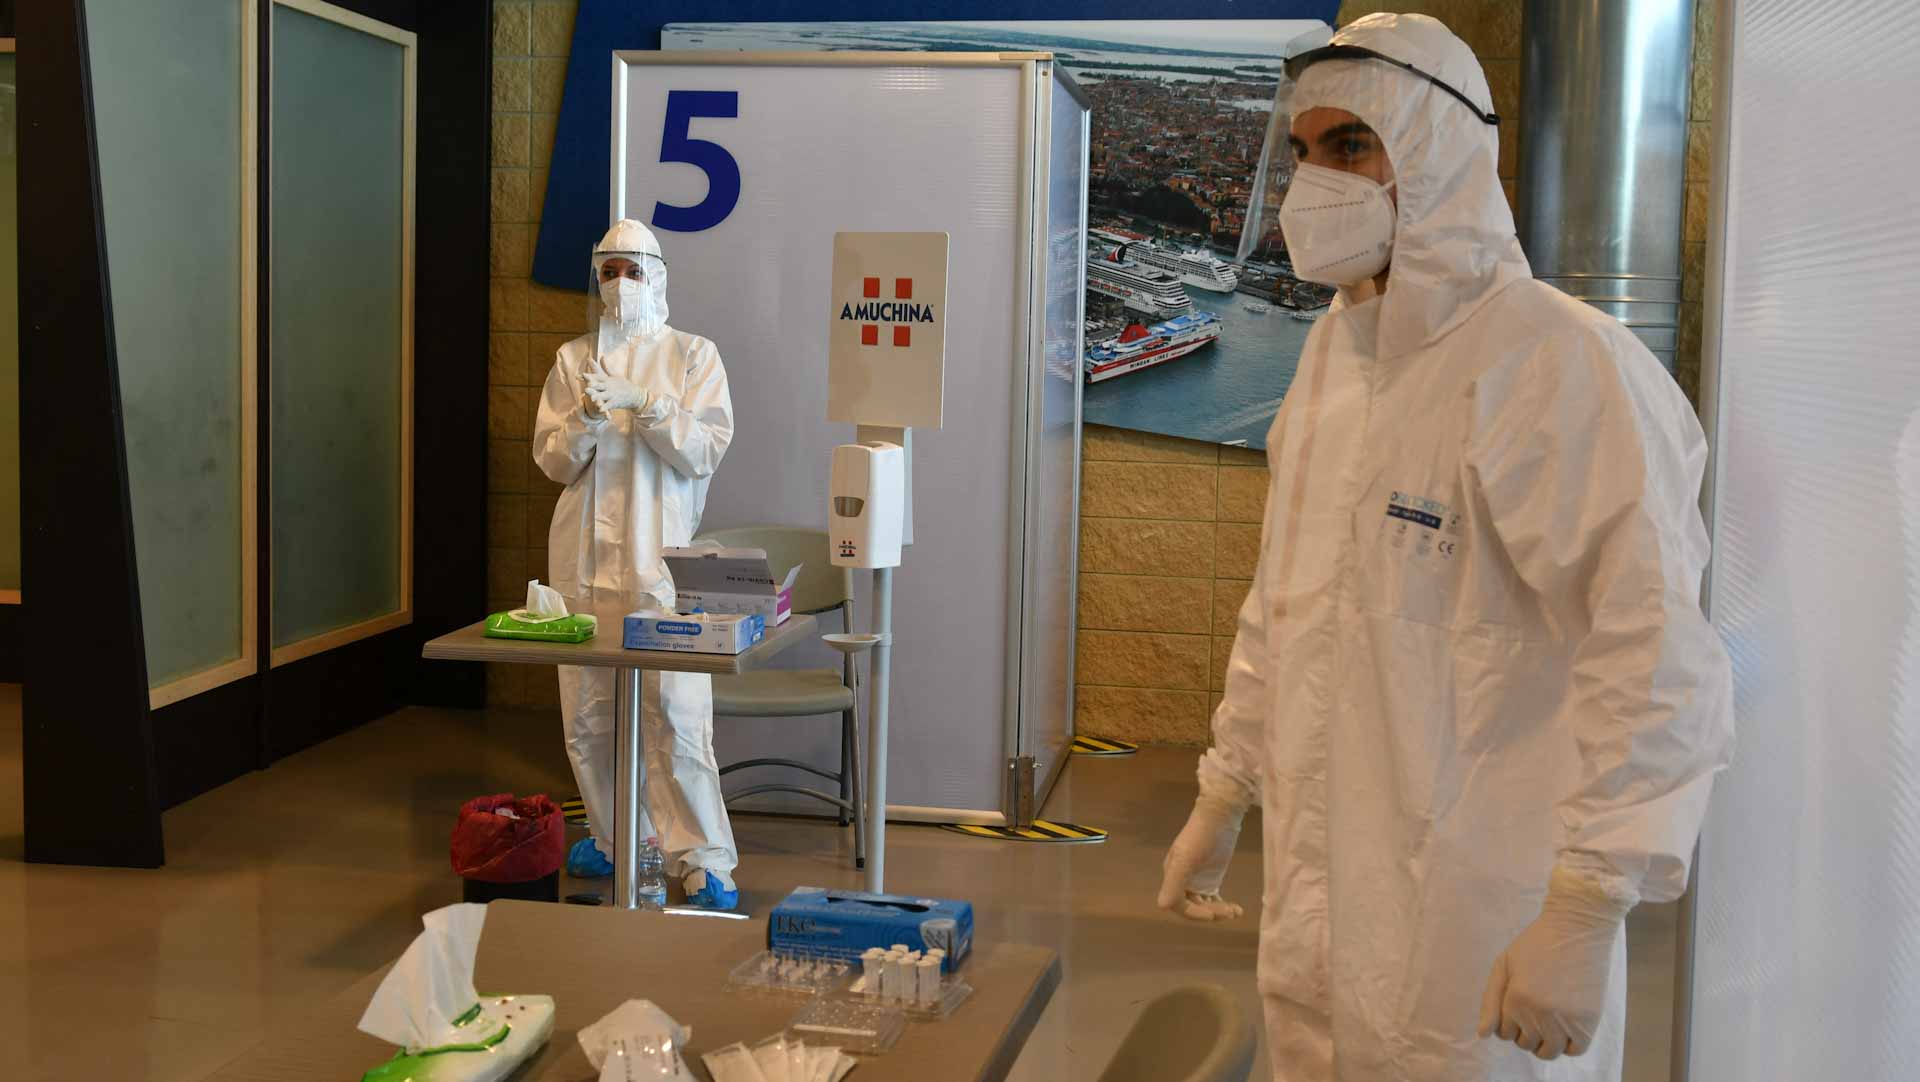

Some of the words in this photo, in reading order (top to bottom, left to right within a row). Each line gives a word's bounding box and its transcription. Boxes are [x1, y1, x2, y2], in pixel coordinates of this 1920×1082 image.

[652, 90, 741, 232] 5
[840, 302, 934, 322] AMUCHINA
[672, 641, 695, 650] gloves
